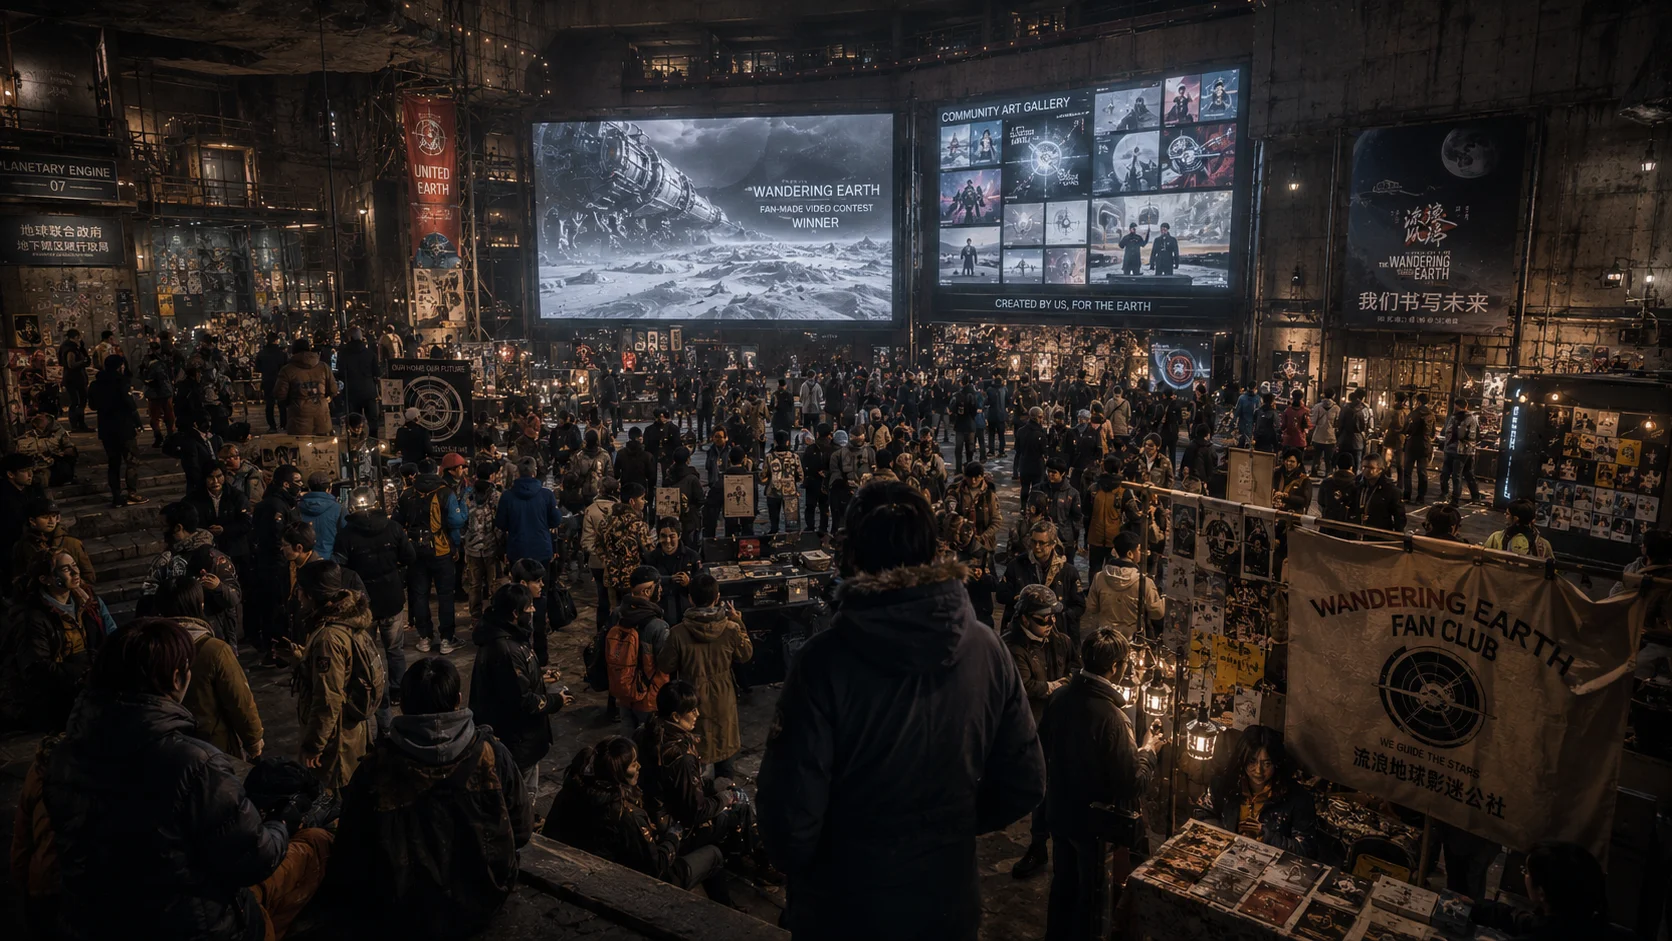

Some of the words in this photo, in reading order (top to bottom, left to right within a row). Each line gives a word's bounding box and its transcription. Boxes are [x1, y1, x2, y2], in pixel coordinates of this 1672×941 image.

[942, 106, 1000, 123] COMMUNITY
[1001, 102, 1022, 115] ART
[1023, 97, 1071, 112] GALLERY
[0, 160, 65, 174] LANETARY
[69, 165, 110, 178] ENGINE
[414, 164, 450, 180] UNITED
[50, 180, 66, 191] 07
[418, 182, 449, 196] EARTH
[753, 185, 833, 197] WANDERING
[837, 184, 880, 196] EARTH
[760, 205, 803, 213] FAN-MADE
[805, 205, 831, 213] VIDEO
[833, 204, 873, 212] CONTEST
[792, 217, 839, 228] WINNER
[1389, 255, 1451, 268] WANDERING
[1414, 267, 1450, 280] EARTH
[995, 299, 1037, 309] CREATED
[1039, 299, 1051, 309] BY
[1054, 300, 1069, 311] US,
[1072, 300, 1092, 310] FOR
[1095, 301, 1114, 310] THE
[1116, 301, 1151, 311] EARTH
[1358, 292, 1489, 313] 我们书写未来
[1310, 586, 1466, 618] WANDERING
[1473, 600, 1576, 677] EARTH
[1391, 614, 1435, 638] FAN
[1441, 619, 1499, 662] CLUB
[1380, 737, 1394, 749] WE
[1396, 742, 1425, 759] GUIDE
[1427, 751, 1445, 767] THE
[1447, 759, 1480, 779] STARS
[1353, 745, 1507, 820] 流浪地球影迷公社
